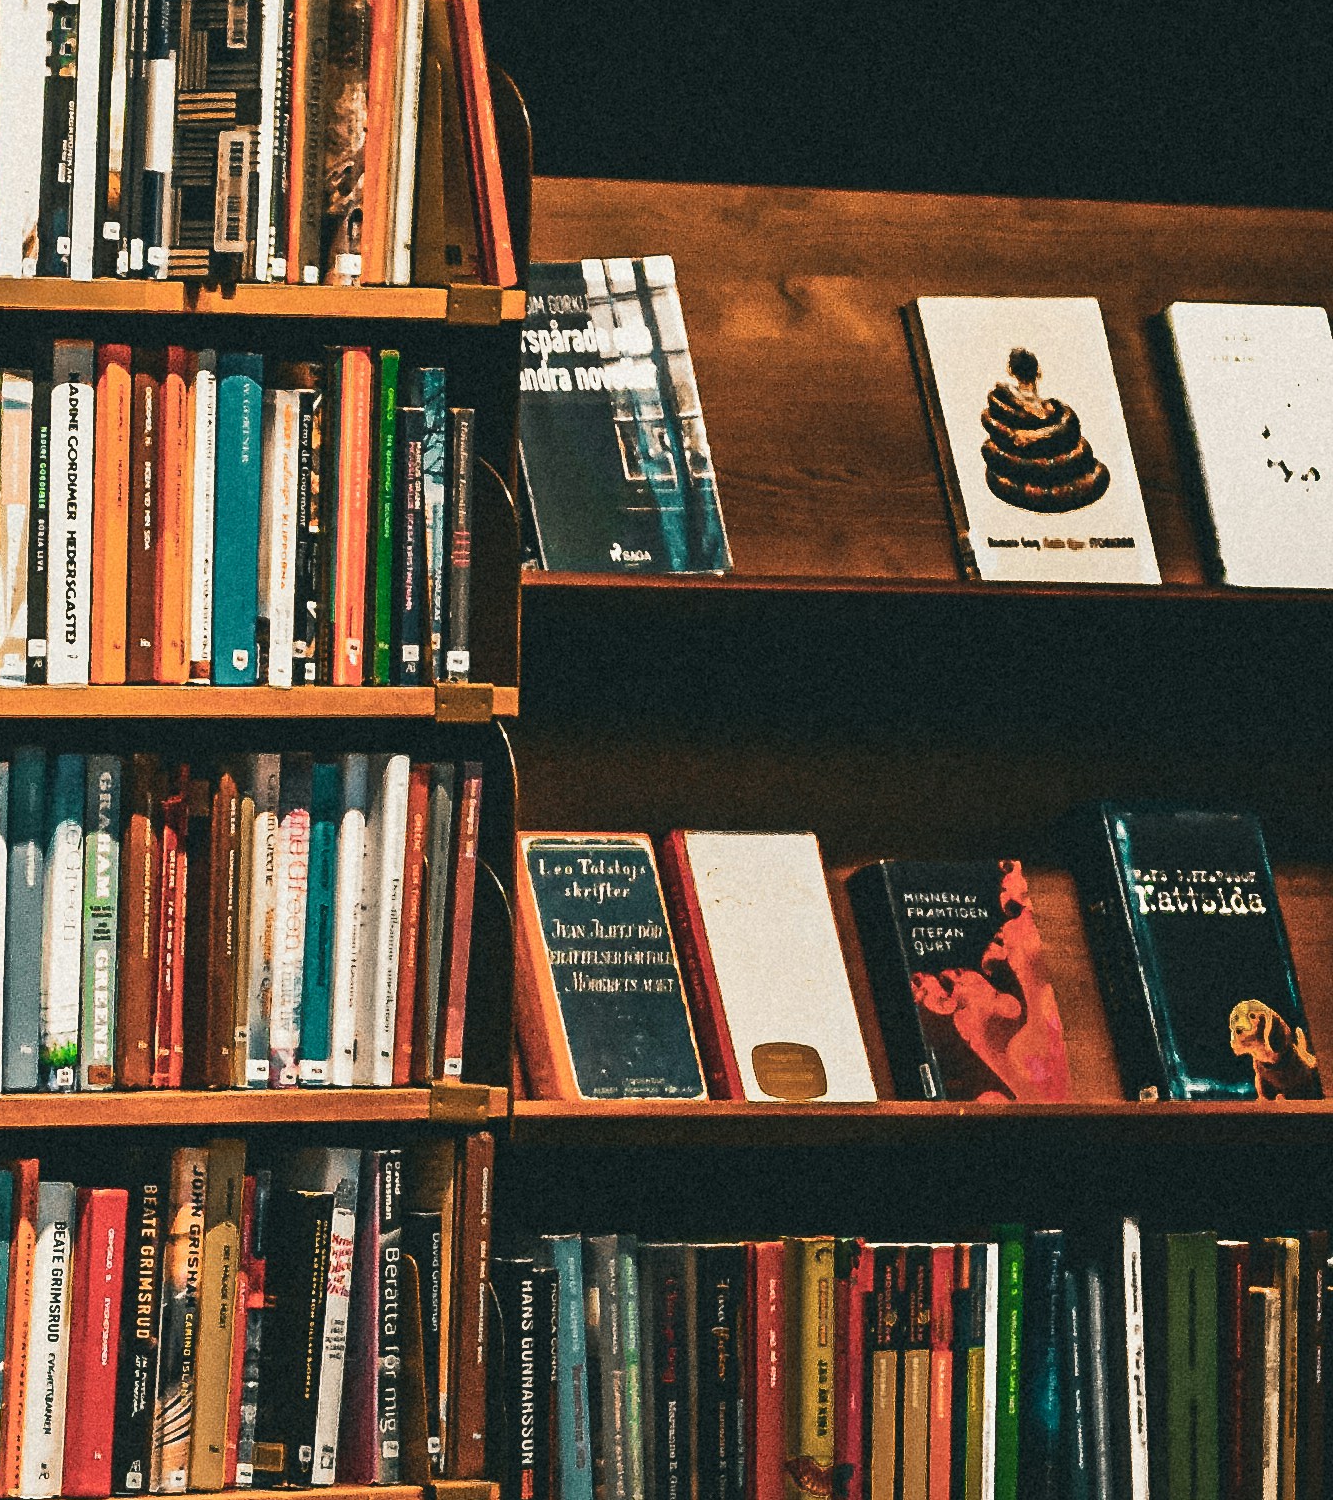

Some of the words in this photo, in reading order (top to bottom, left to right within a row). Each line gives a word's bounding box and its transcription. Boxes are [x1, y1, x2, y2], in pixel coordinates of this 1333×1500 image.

[68, 373, 79, 431] NADINE
[301, 414, 311, 447] Remy
[67, 436, 78, 520] GORDIMER
[301, 451, 310, 465] de
[97, 772, 111, 897] GRAHAM
[539, 860, 572, 878] Leo
[565, 882, 630, 901] skrifter
[1138, 885, 1265, 917] Kattsida
[95, 949, 108, 1059] GREENE
[142, 1185, 156, 1237] BEATE
[191, 1165, 202, 1217] JOHN
[52, 1221, 67, 1263] BEATE
[186, 1224, 200, 1307] GRISHAM
[48, 1268, 65, 1342] GRIMSRUD
[136, 1246, 155, 1338] GRIMSRUD
[523, 1281, 533, 1330] HANS
[380, 1388, 398, 1432] mig
[522, 1338, 533, 1464] GUNNARSSON
